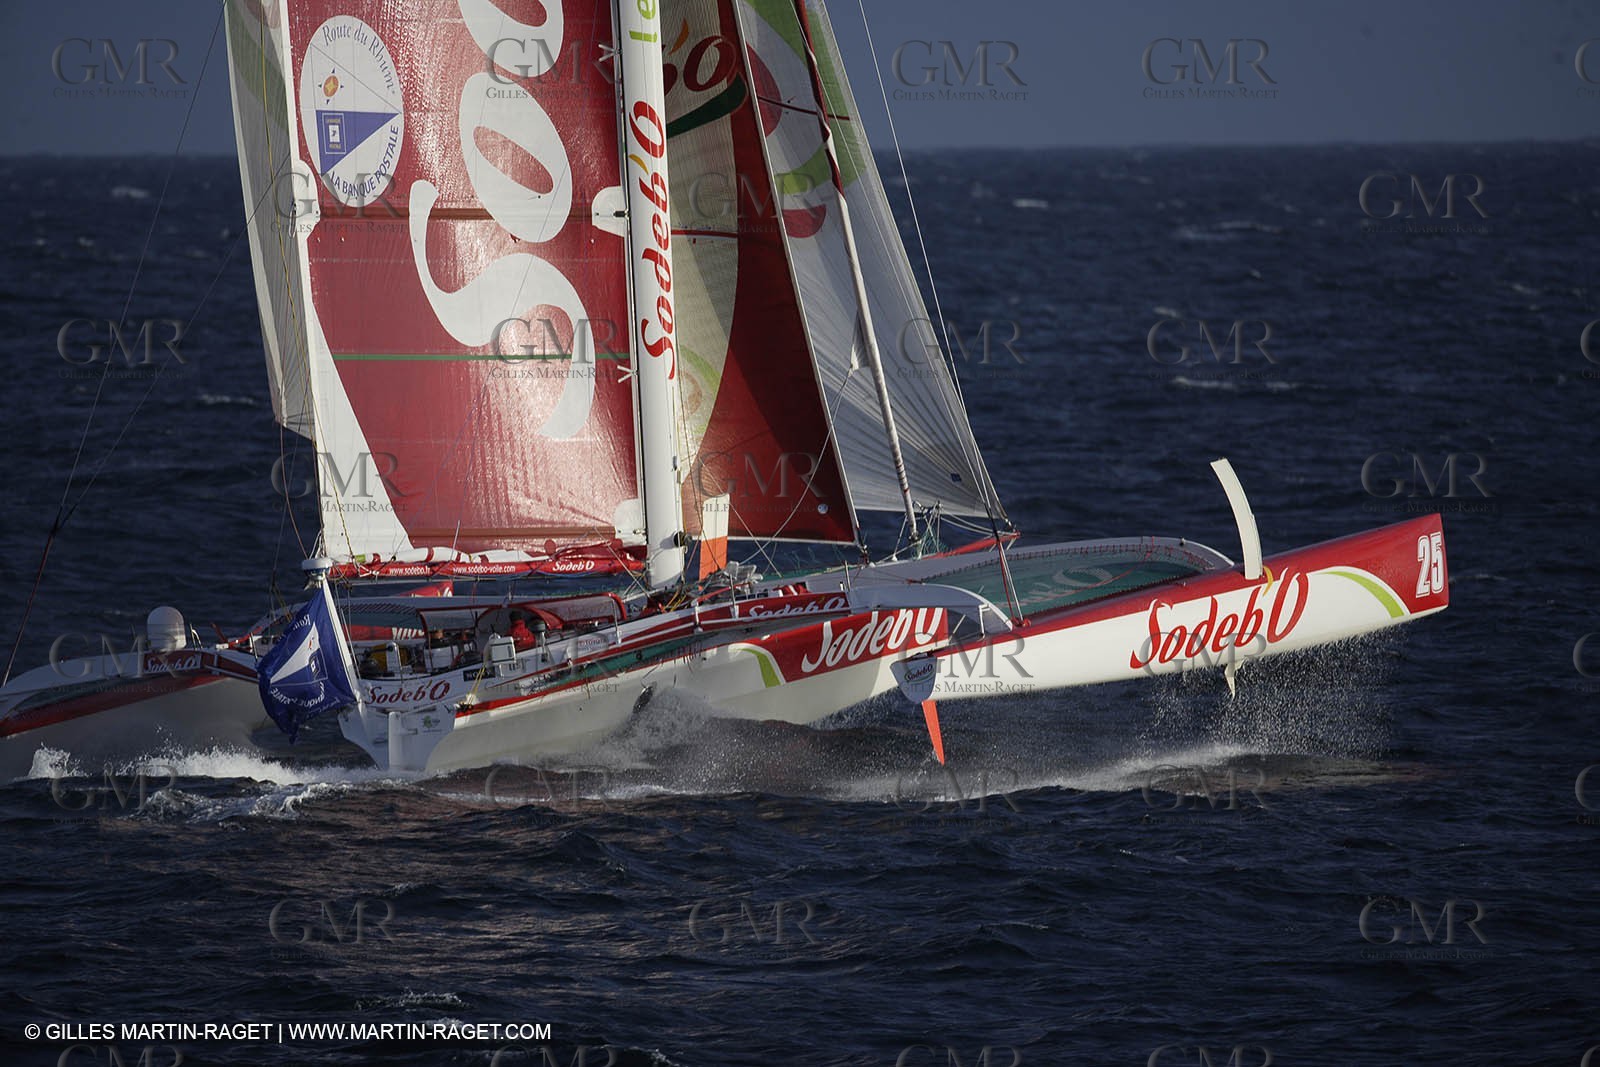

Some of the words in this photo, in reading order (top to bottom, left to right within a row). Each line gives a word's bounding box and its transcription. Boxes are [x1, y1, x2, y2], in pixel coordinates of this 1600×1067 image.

[322, 24, 352, 47] Route
[353, 22, 368, 46] du
[330, 170, 340, 189] LA
[342, 176, 377, 198] BANQUE
[375, 125, 399, 184] POSTALE
[1416, 531, 1444, 598] 25
